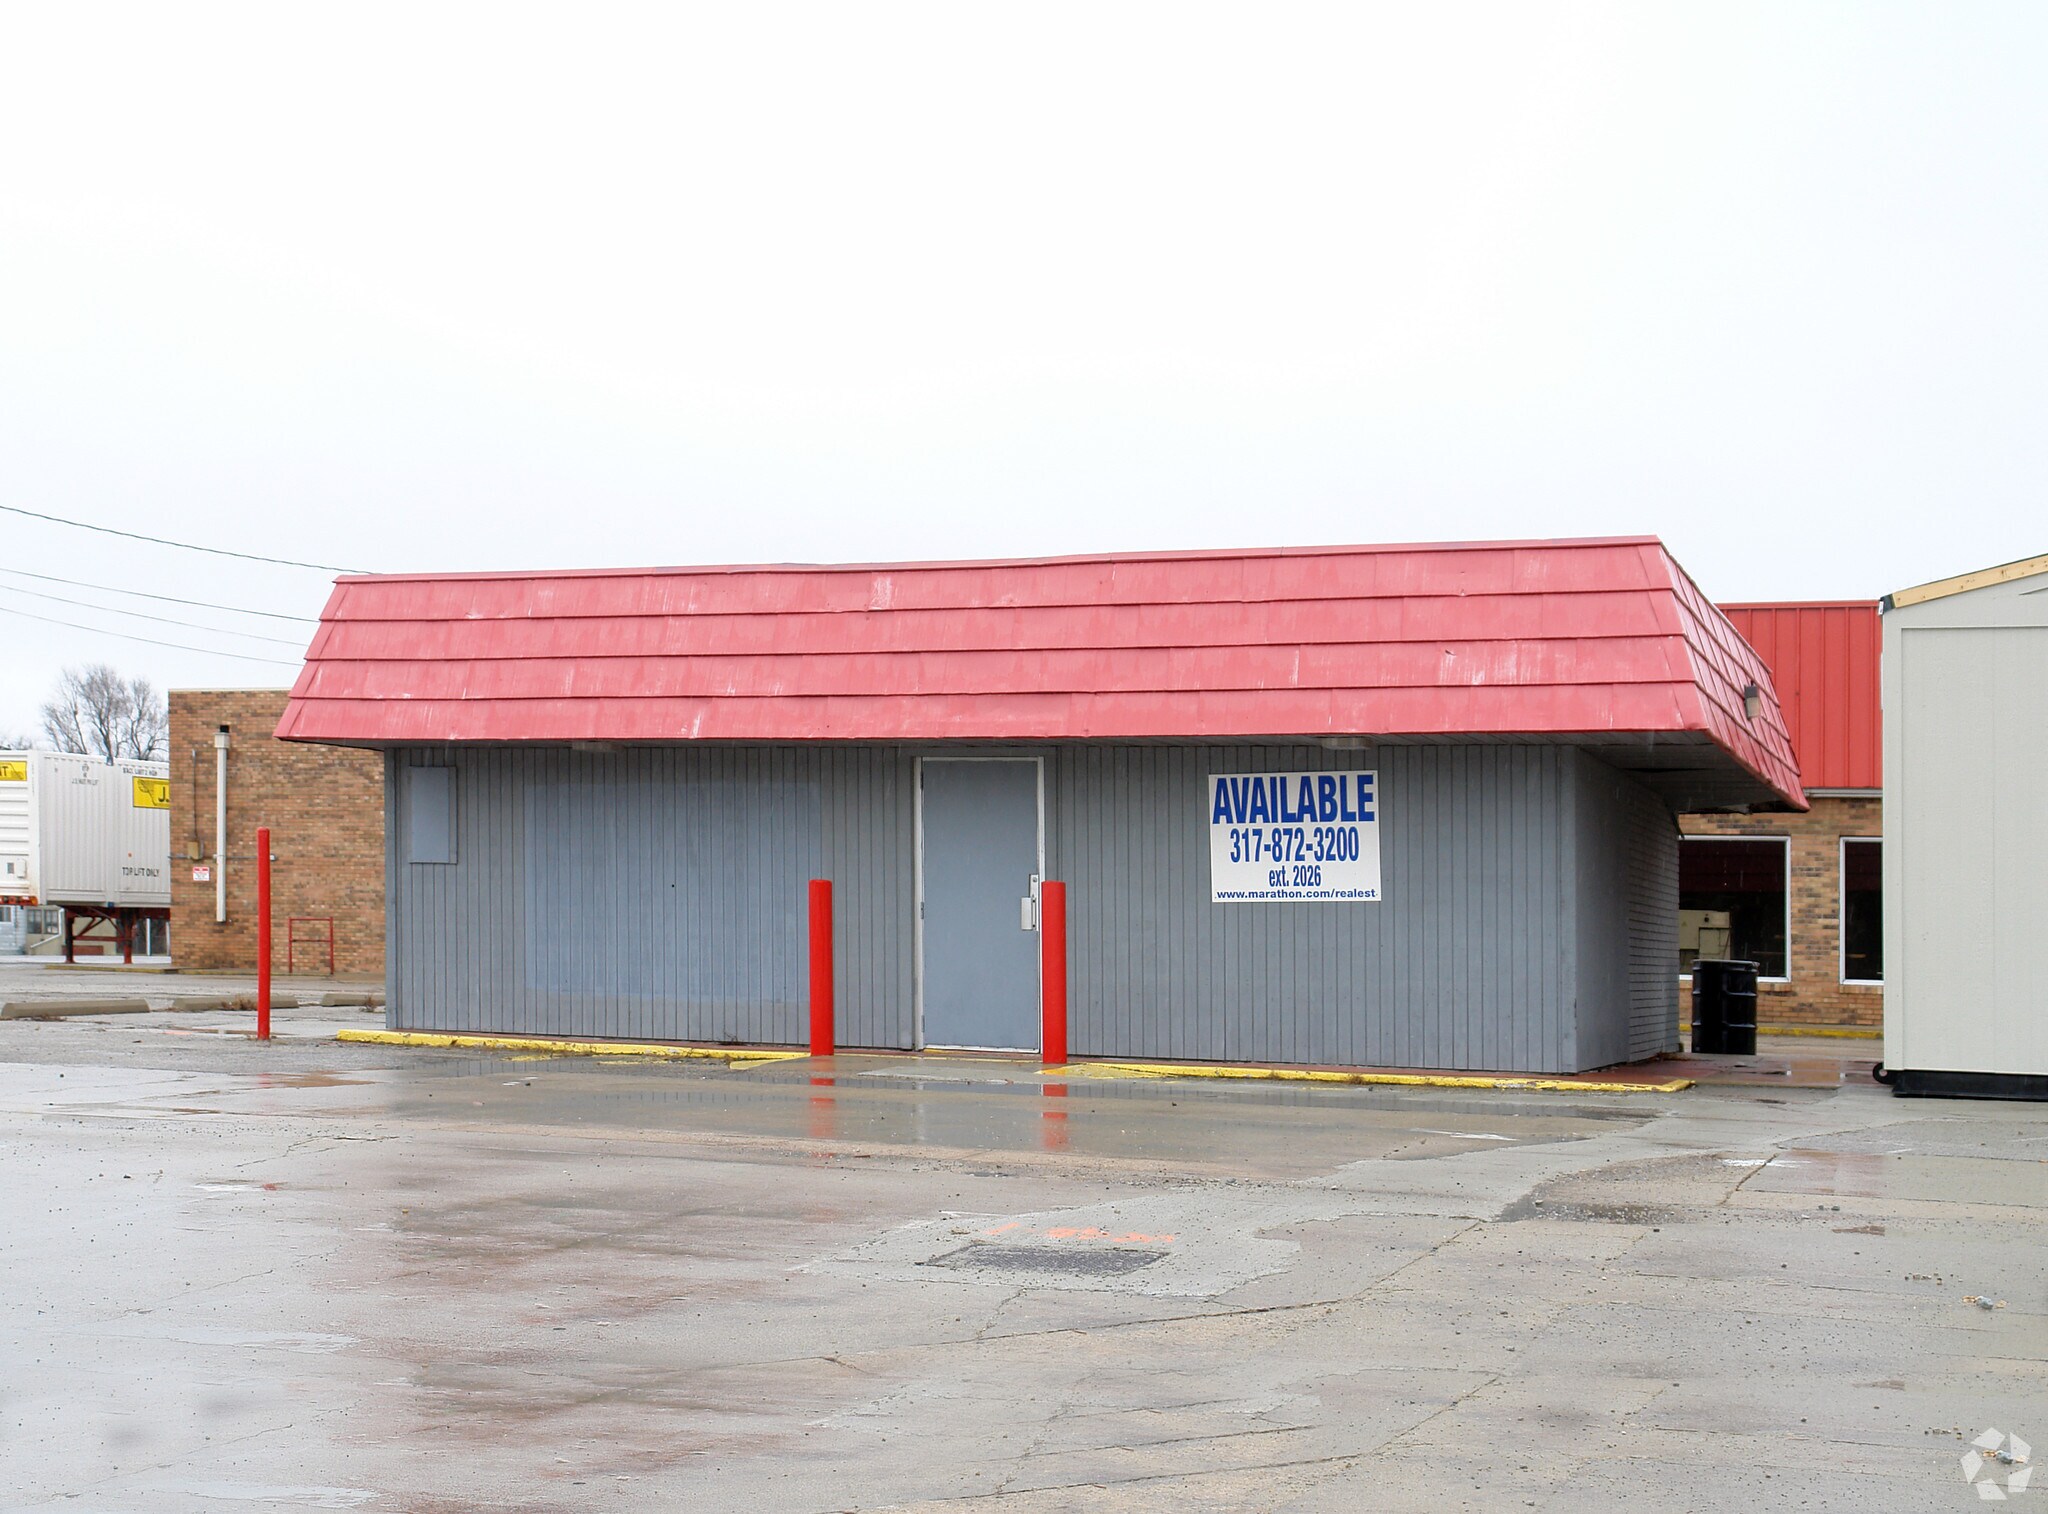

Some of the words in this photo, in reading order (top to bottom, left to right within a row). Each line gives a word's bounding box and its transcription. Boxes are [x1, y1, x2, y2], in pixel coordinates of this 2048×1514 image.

[1212, 774, 1375, 825] AVAILABLE
[1230, 826, 1360, 863] 317-872-3200
[133, 867, 145, 877] LFT
[1268, 865, 1290, 887] ext.
[1292, 865, 1321, 887] 2026
[1216, 888, 1376, 899] www.marathon.com/realest
